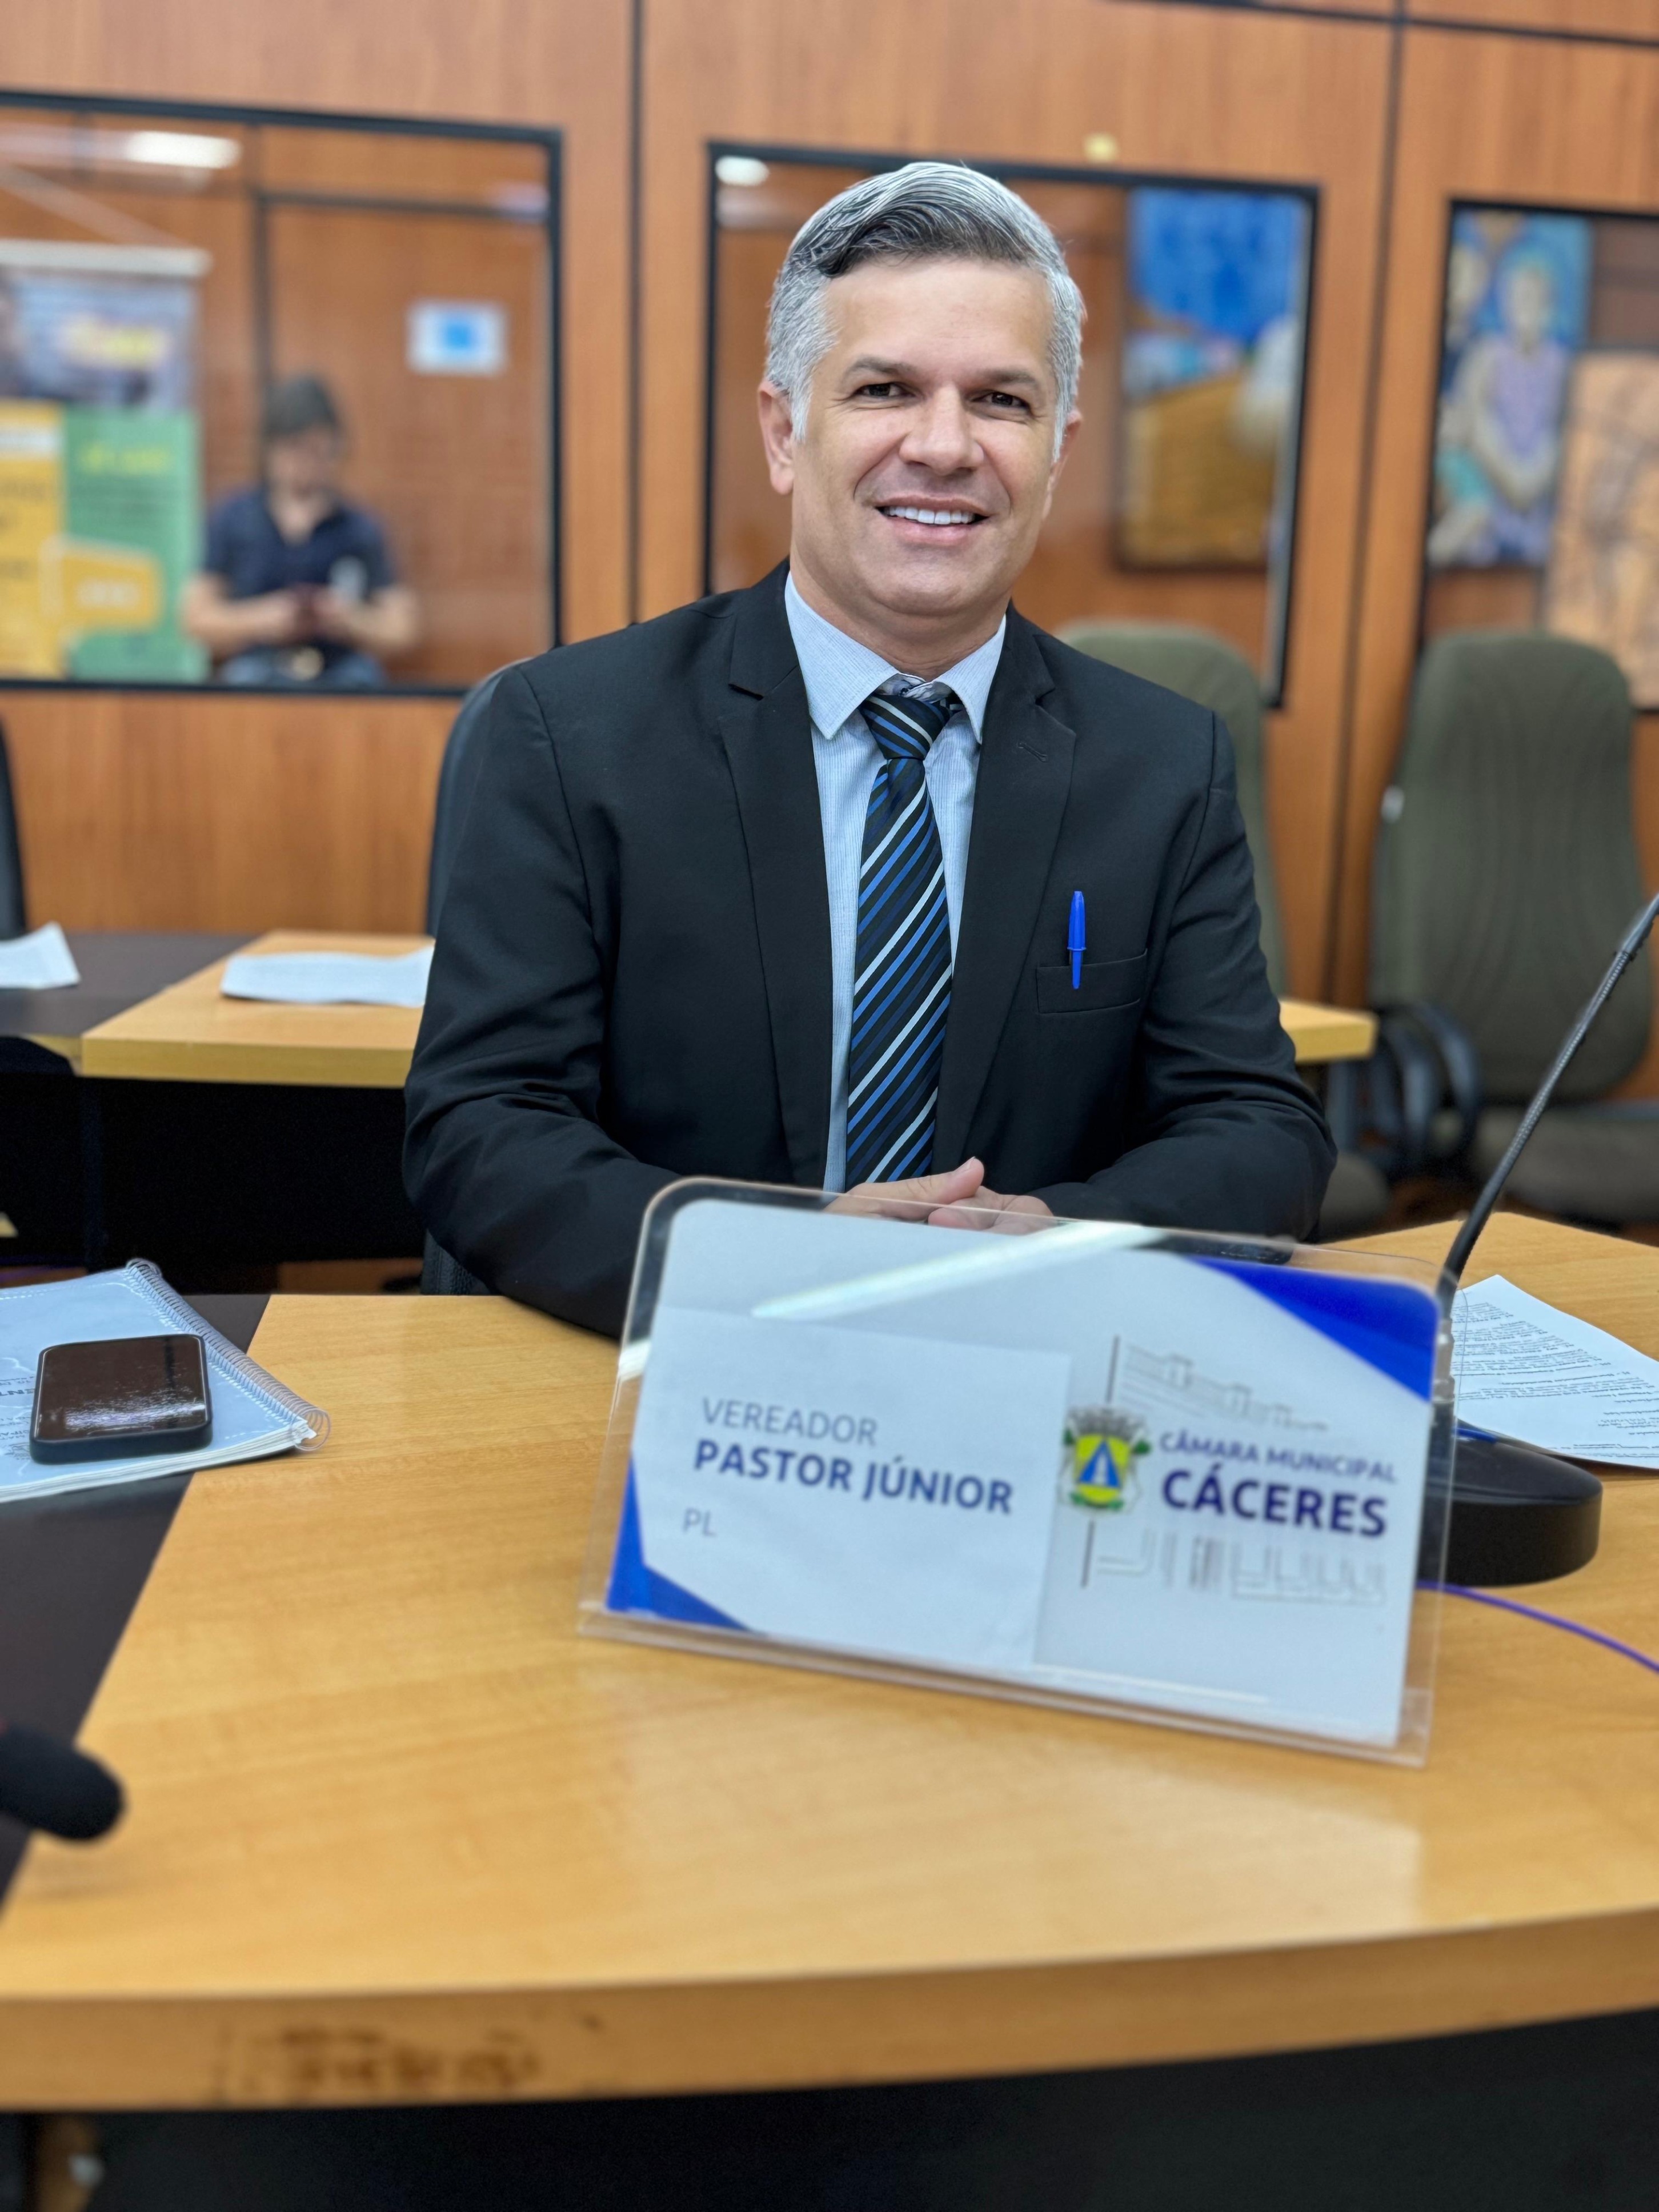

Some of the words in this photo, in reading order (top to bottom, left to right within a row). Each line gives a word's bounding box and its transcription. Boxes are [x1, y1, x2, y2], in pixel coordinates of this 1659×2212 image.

[702, 1396, 878, 1446] VEREADOR
[693, 1438, 853, 1493] PASTOR
[862, 1455, 1013, 1516] JÚNIOR
[1160, 1429, 1259, 1463] CÂMARA
[1267, 1448, 1396, 1484] MUNICIPAL
[683, 1507, 717, 1537] PL
[1161, 1462, 1388, 1537] CÁCERES
